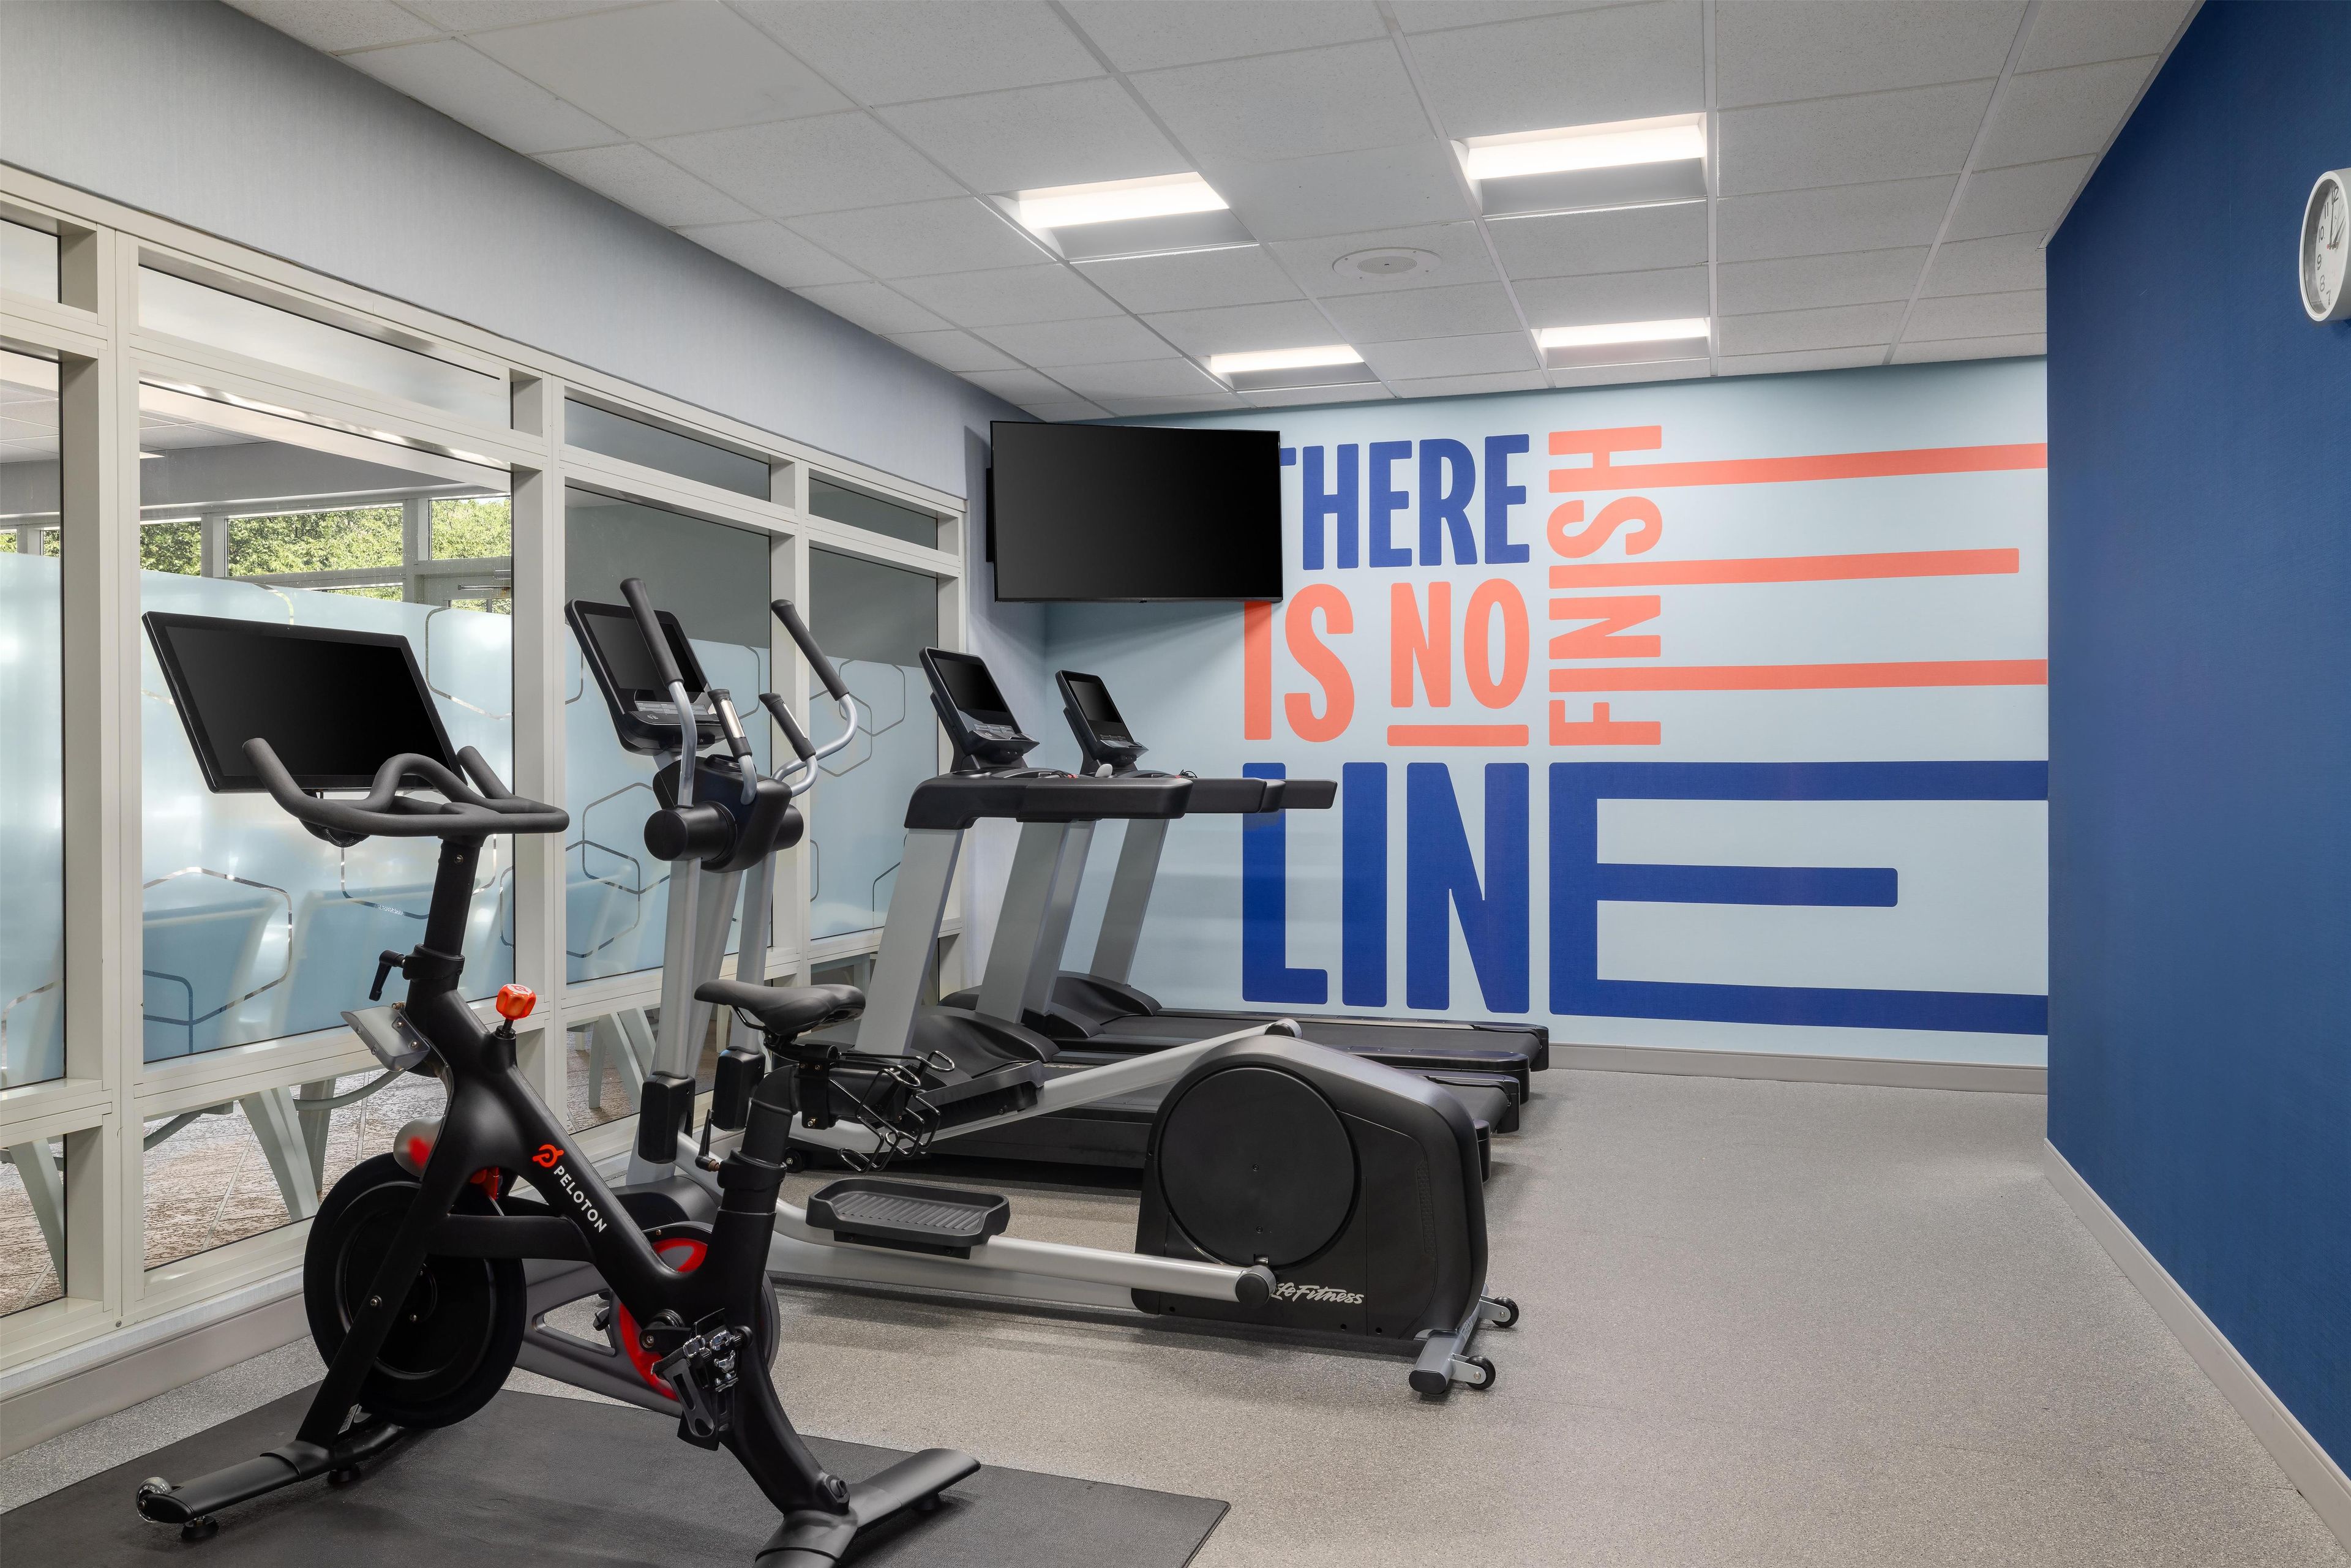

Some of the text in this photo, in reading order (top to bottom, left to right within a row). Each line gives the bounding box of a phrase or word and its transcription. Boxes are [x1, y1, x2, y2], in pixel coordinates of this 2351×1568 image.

[2331, 186, 2339, 205] 12
[2324, 201, 2329, 220] 11
[2318, 225, 2325, 244] 10
[2317, 253, 2322, 271] 9
[2319, 274, 2325, 292] 8
[2327, 289, 2331, 306] 7
[1244, 579, 1530, 743] IS NO
[1242, 760, 2048, 1035] LINE
[553, 1165, 607, 1233] PELOTON
